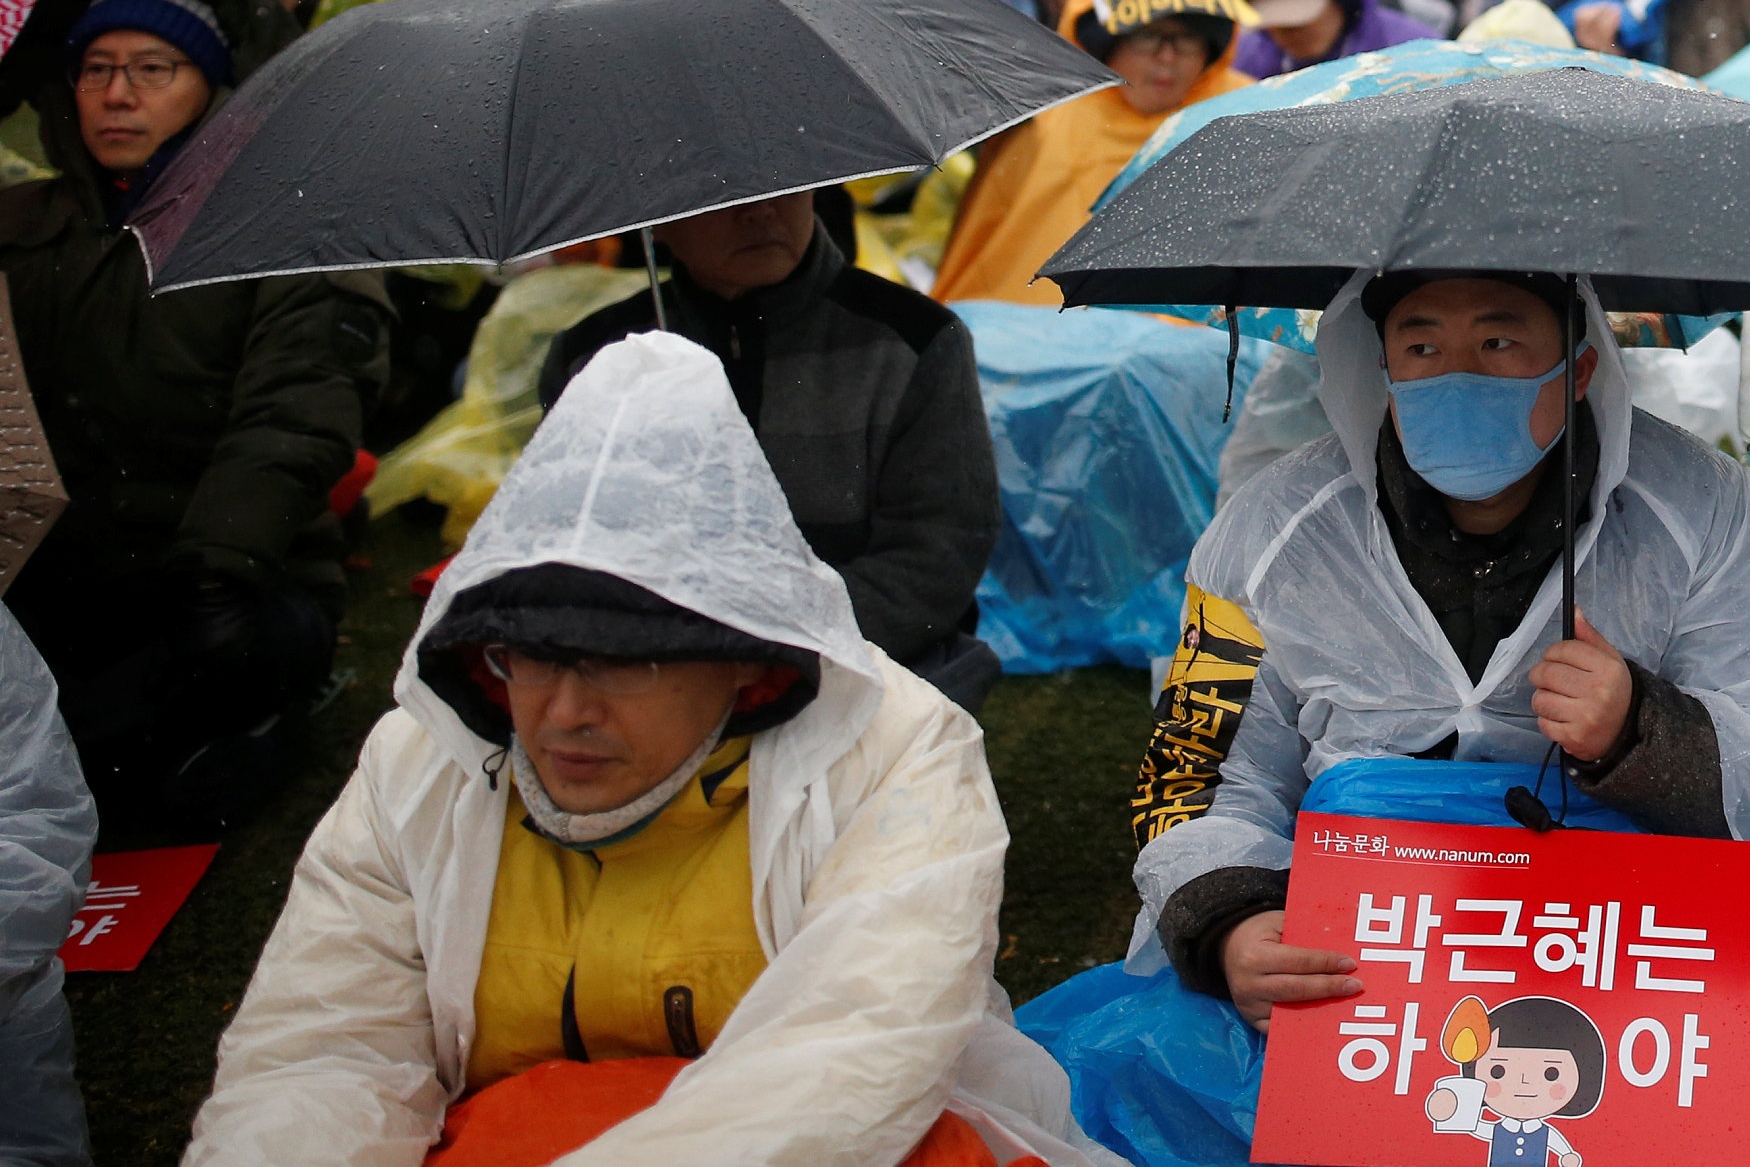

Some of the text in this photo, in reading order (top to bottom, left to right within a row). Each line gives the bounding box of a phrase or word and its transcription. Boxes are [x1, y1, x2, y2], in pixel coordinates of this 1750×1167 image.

[1312, 830, 1531, 866] 나눔문화 www.nanum.com
[1353, 892, 1716, 994] 박근혜는
[1336, 1000, 1710, 1108] 하 야
